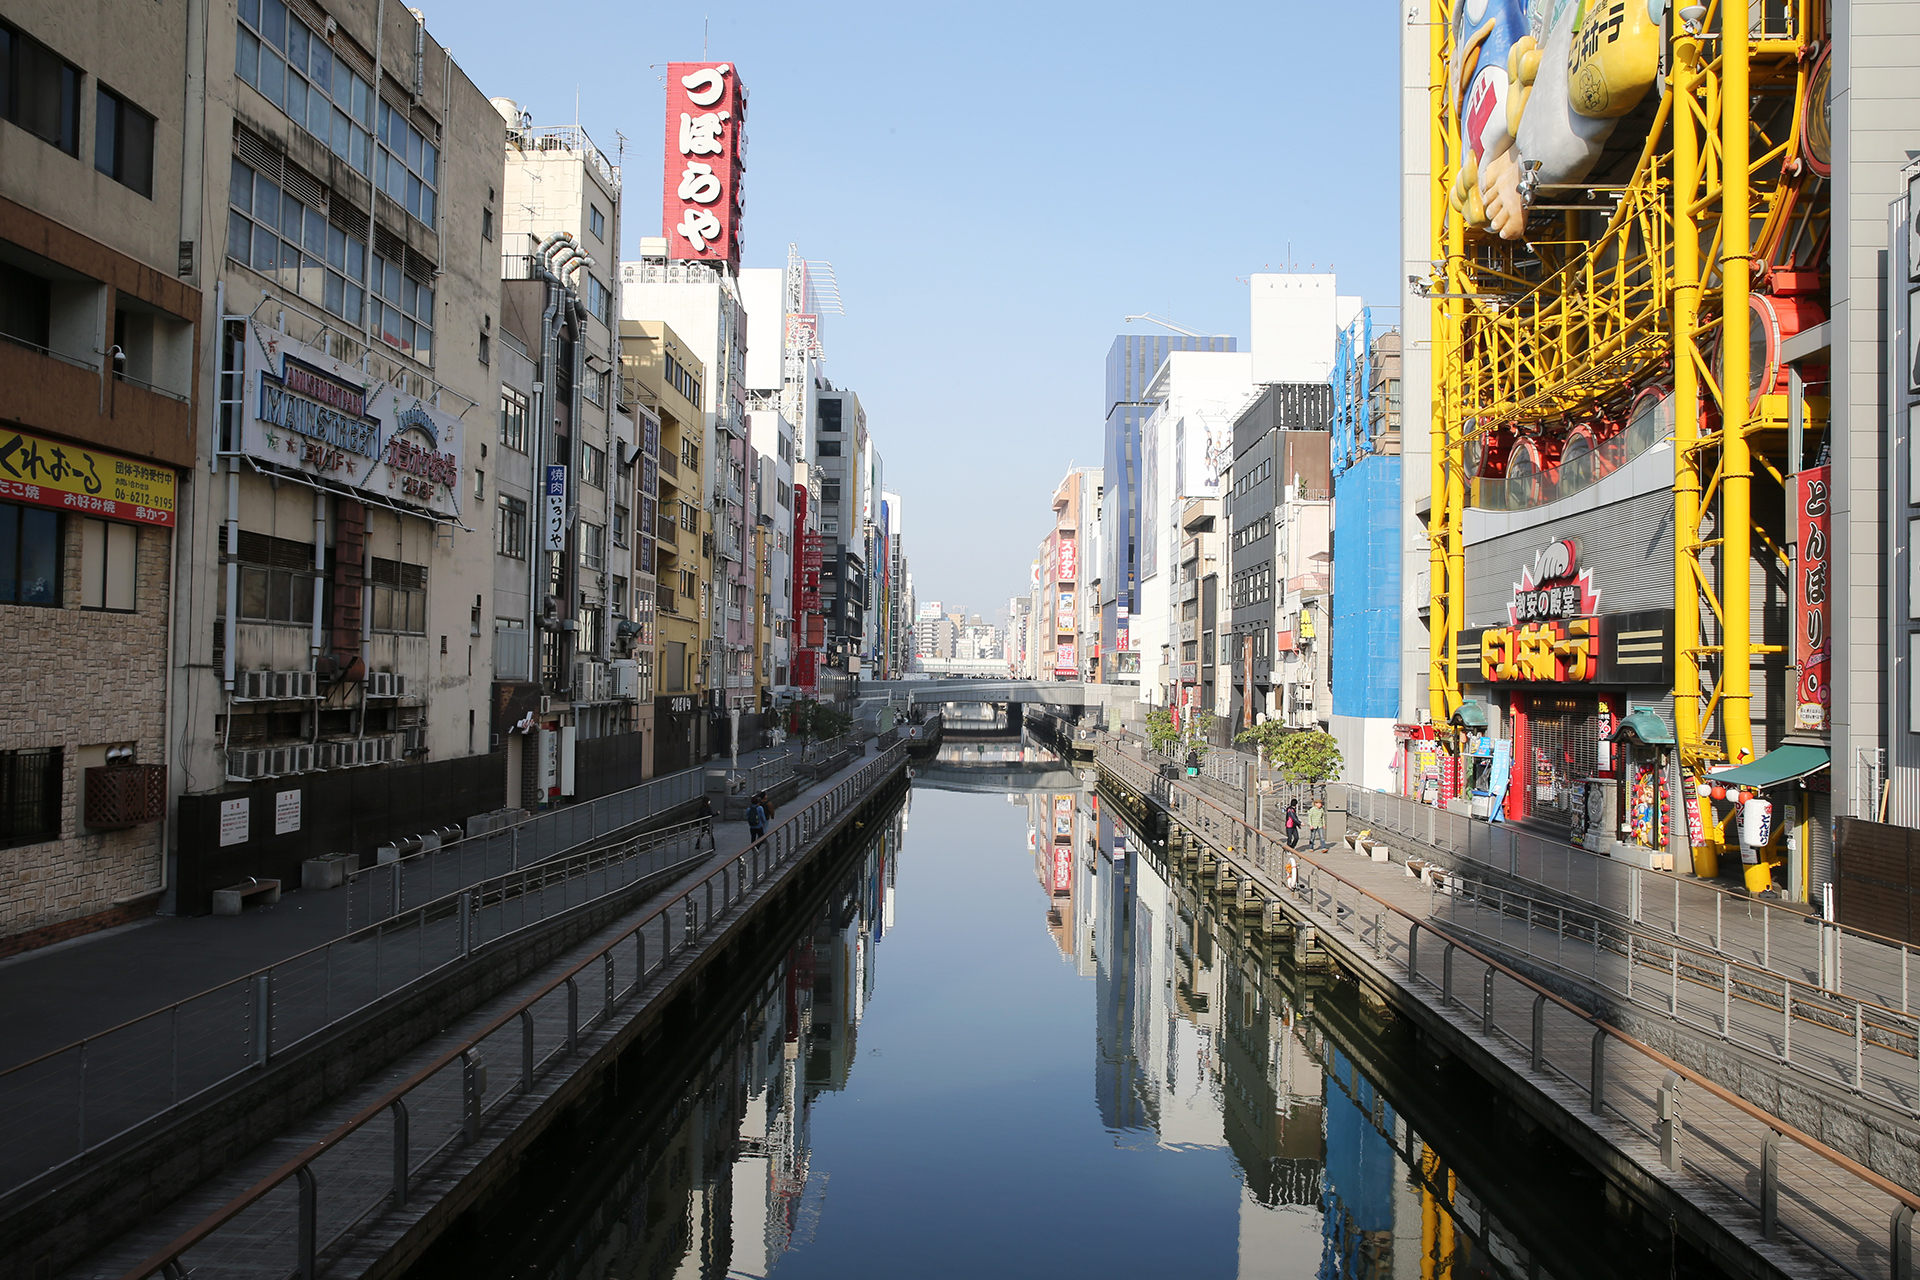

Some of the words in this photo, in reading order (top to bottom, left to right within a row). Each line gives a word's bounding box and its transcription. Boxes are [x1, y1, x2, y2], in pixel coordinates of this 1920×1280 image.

[677, 63, 731, 251] づぼらや
[0, 434, 102, 494] くれおーる
[115, 460, 173, 486] 団体予約受付中
[550, 468, 564, 494] 焼肉
[63, 493, 116, 514] お好み焼
[135, 505, 168, 522] 串かつ
[114, 487, 174, 510] 06-6212-9195
[1060, 540, 1074, 580] スポタカ
[1804, 479, 1828, 650] とんぼり
[1515, 586, 1576, 620] 激安の殿堂
